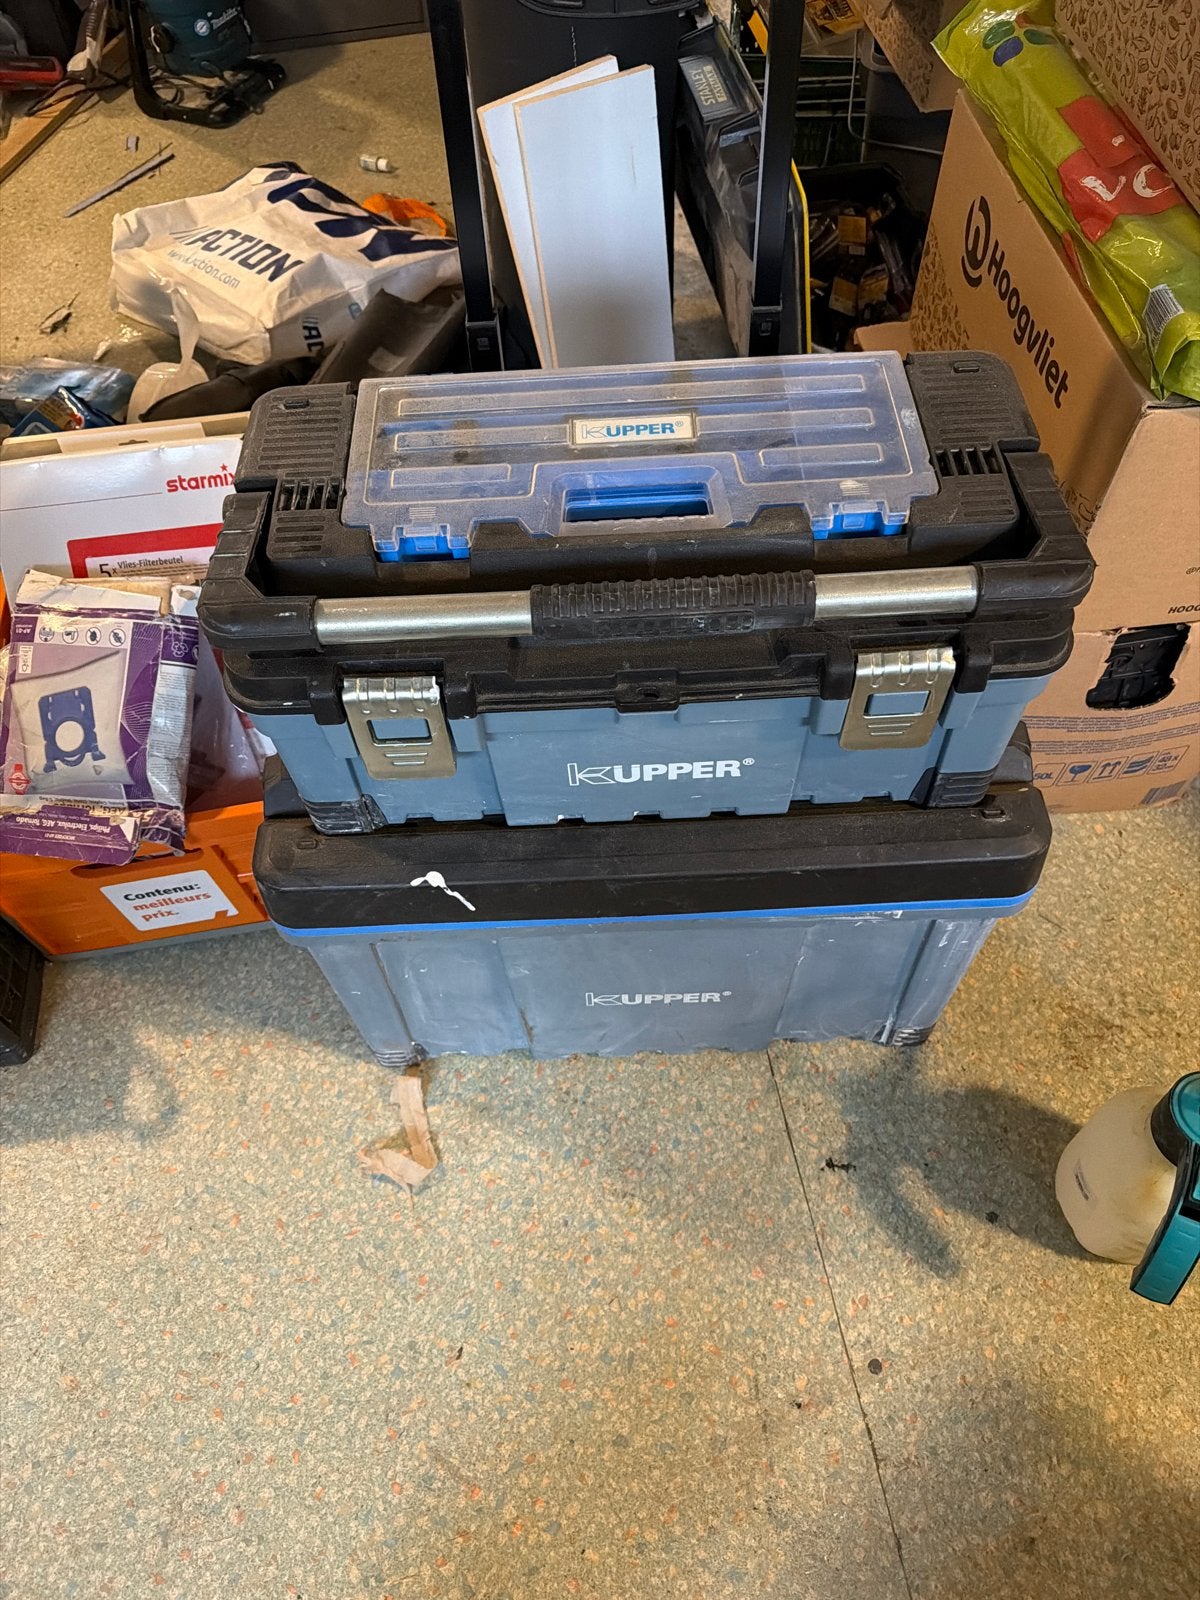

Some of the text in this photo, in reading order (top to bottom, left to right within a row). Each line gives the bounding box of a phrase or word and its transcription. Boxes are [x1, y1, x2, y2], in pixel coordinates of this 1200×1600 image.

[689, 69, 716, 106] STANLEY
[183, 228, 305, 283] ACTION
[987, 239, 1069, 409] Hoogvliet
[117, 556, 184, 570] Vlies-Filterbeutel
[15, 816, 41, 826] Tornado
[123, 882, 202, 902] Contenu:
[132, 892, 212, 911] meilleurs
[141, 909, 180, 922] prix.
